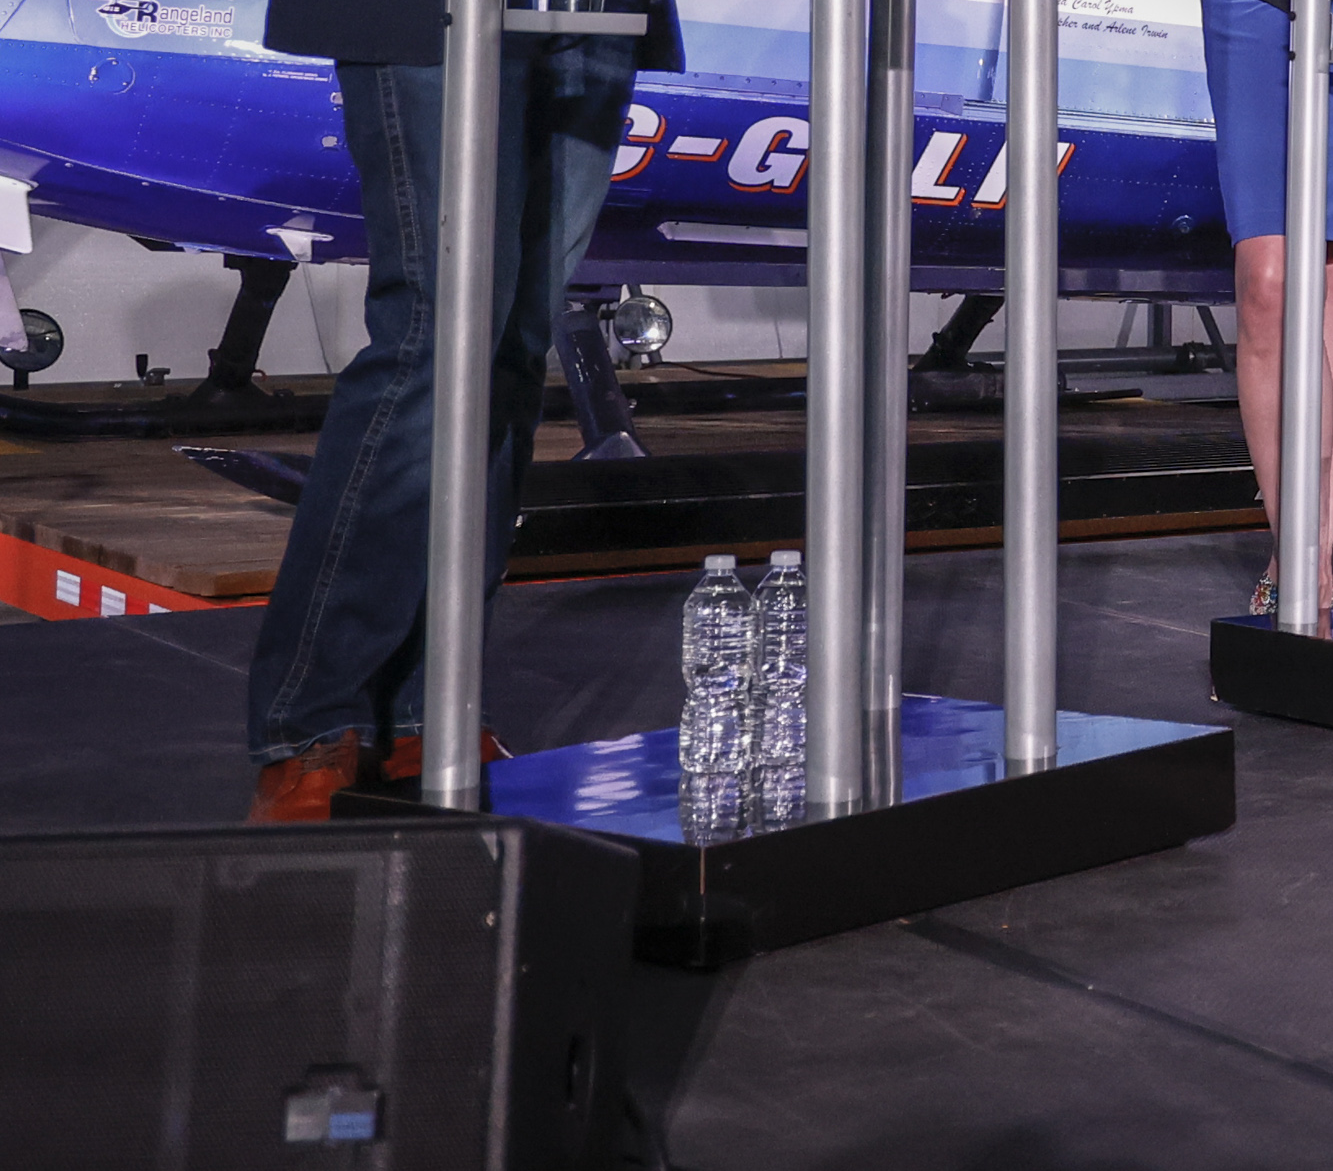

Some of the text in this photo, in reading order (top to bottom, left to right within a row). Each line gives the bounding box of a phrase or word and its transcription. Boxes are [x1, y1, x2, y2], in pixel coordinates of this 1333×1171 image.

[137, 0, 233, 25] Rangeland
[121, 21, 232, 38] HELICOPTERS INC
[1082, 20, 1102, 31] and
